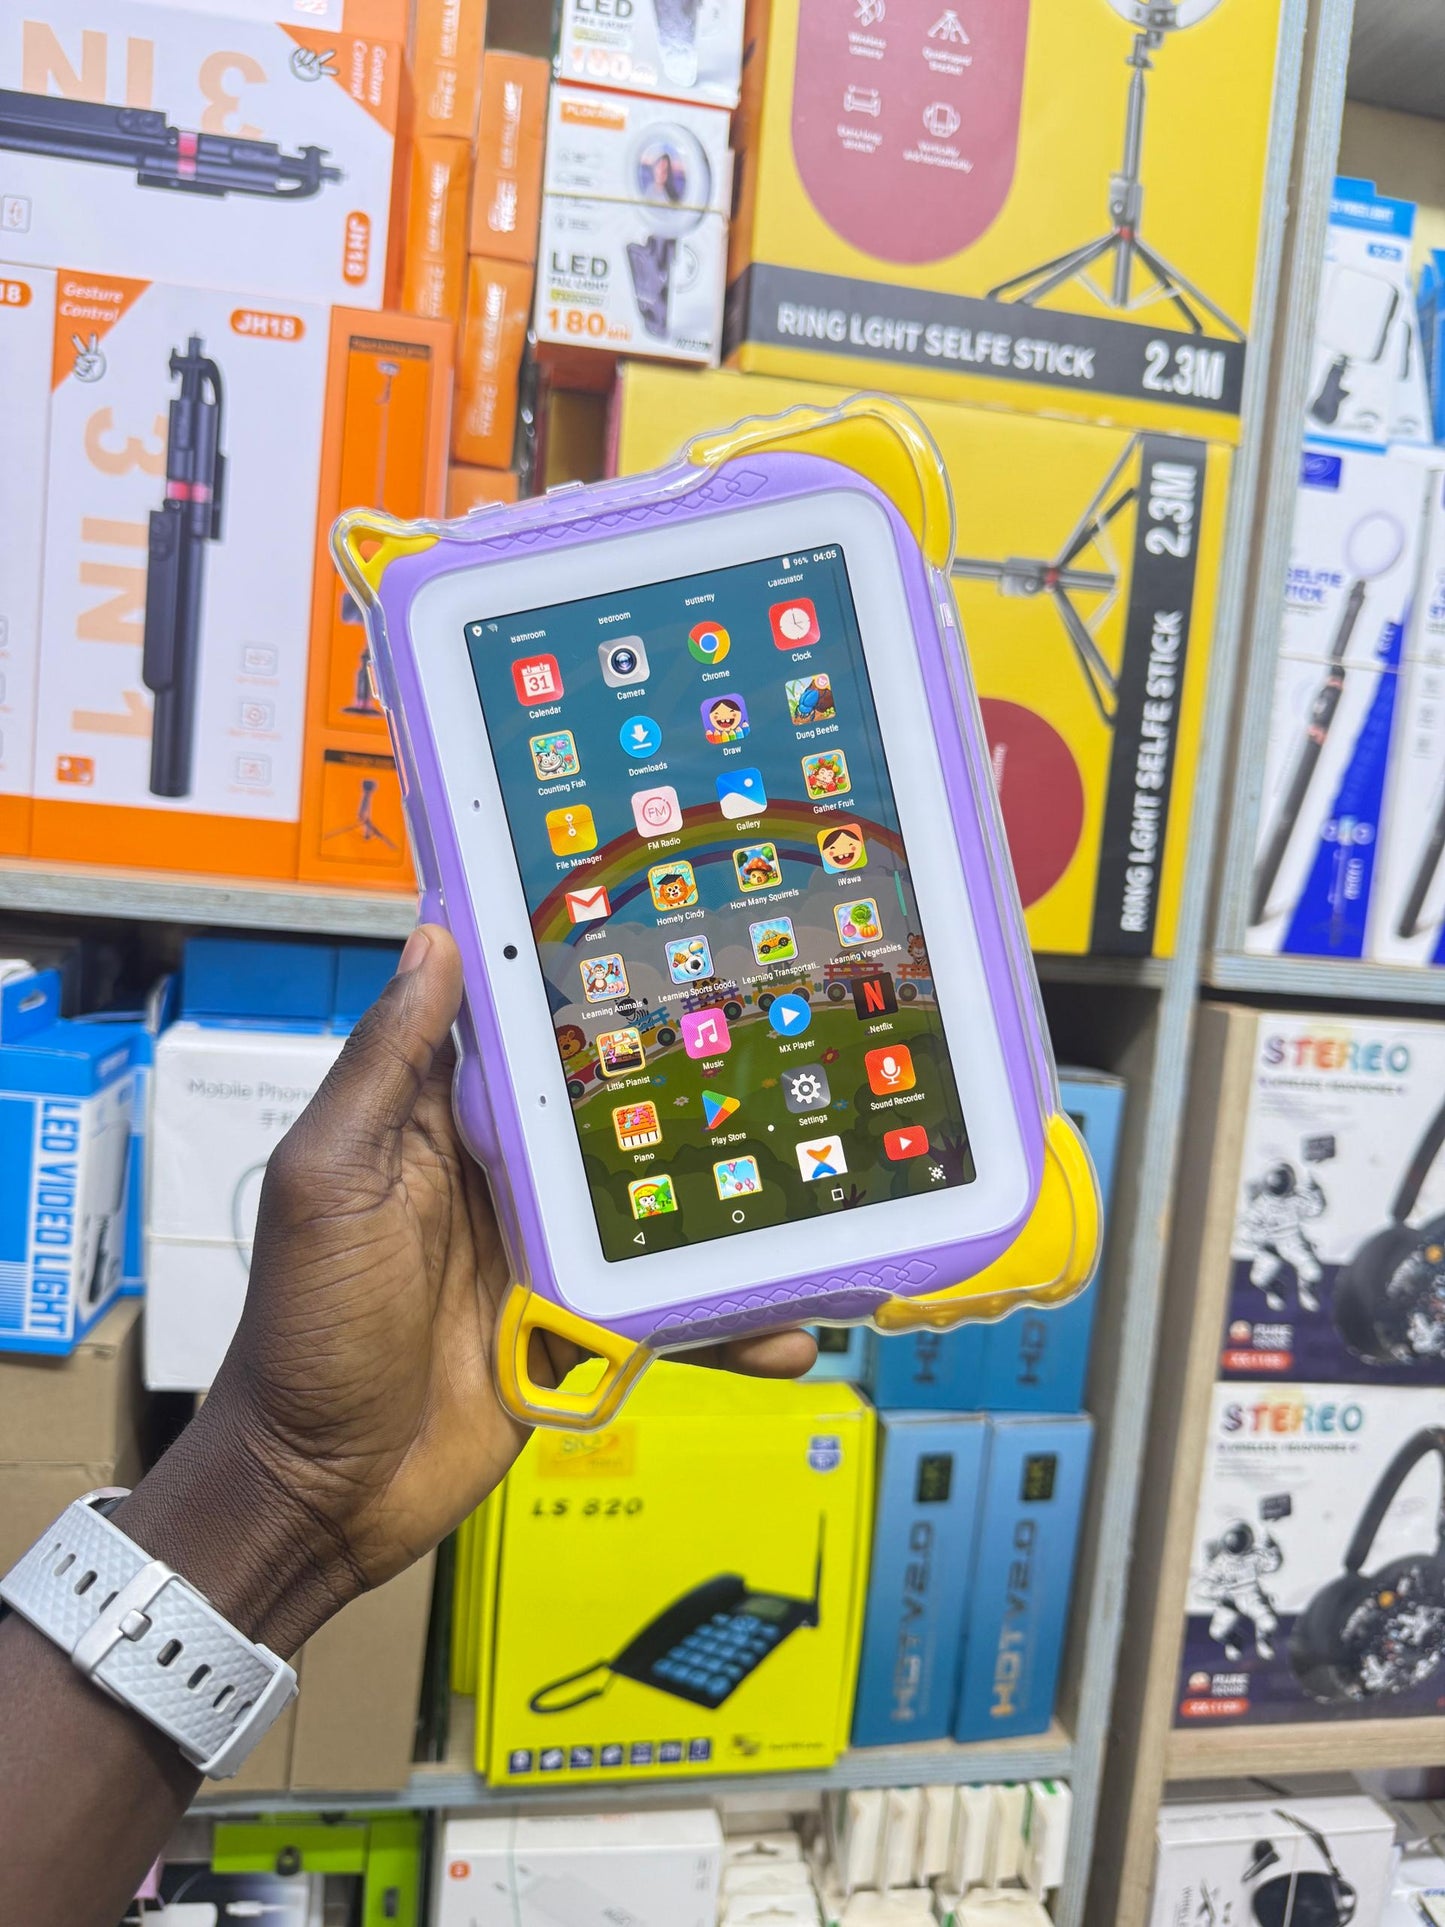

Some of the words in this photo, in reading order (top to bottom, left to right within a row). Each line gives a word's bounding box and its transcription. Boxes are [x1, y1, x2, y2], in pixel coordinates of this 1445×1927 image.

[351, 40, 368, 102] Control
[368, 45, 388, 106] Gesture
[550, 251, 610, 278] LED
[63, 281, 125, 304] Gesture
[59, 301, 120, 322] Control
[236, 313, 298, 339] JH18
[547, 309, 606, 339] 180
[776, 302, 847, 340] RING
[850, 312, 924, 350] LGHT
[925, 322, 1012, 366] SELFE
[1013, 336, 1097, 379] STICK
[1142, 340, 1226, 399] 2.3M
[1144, 461, 1199, 559] 2.3M
[793, 556, 809, 566] 96%
[813, 549, 837, 563] 04:05
[791, 651, 812, 662] Clock
[1145, 610, 1183, 699] STICK
[528, 676, 551, 692] 31
[701, 669, 731, 682] Chrome
[616, 688, 646, 700] Camera
[529, 705, 562, 719] Calendar
[796, 729, 815, 740] Dung
[816, 723, 839, 736] Beetle
[723, 746, 742, 756] Draw
[1134, 701, 1172, 791] SELFE
[628, 761, 668, 777] Downloads
[538, 782, 571, 796] Counting
[571, 779, 586, 790] Fish
[647, 805, 667, 819] FM
[813, 802, 837, 814] Gather
[838, 798, 855, 809] Fruit
[736, 819, 761, 831] Gallery
[1128, 795, 1161, 864] LGHT
[647, 840, 659, 850] FM
[660, 836, 681, 848] Radio
[556, 859, 570, 870] File
[570, 853, 603, 867] Manager
[837, 874, 862, 887] iWawa
[730, 899, 747, 910] How
[747, 894, 767, 906] Many
[768, 888, 800, 903] Squirrels
[1120, 866, 1155, 933] RING
[656, 913, 684, 926] Homely
[685, 909, 705, 921] Cindy
[584, 930, 607, 942] Gmail
[829, 951, 861, 965] Learning
[861, 942, 902, 959] Vegetables
[742, 971, 773, 985] Learning
[658, 989, 690, 1003] Learning
[690, 984, 713, 998] Sports
[713, 979, 737, 992] Goods
[581, 1005, 613, 1020] Learning
[614, 1000, 644, 1014] Animals
[869, 1022, 893, 1034] Netflix
[779, 1044, 792, 1054] MX
[792, 1039, 815, 1051] Player
[1263, 1034, 1411, 1075] STEREO
[702, 1059, 725, 1070] Music
[188, 1079, 253, 1100] Mobile
[606, 1080, 625, 1092] Little
[626, 1075, 651, 1088] Pianist
[870, 1099, 893, 1111] Sound
[894, 1092, 926, 1105] Recorder
[42, 1101, 81, 1154] LED
[798, 1114, 828, 1127] Settings
[711, 1136, 727, 1147] Play
[728, 1131, 747, 1142] Store
[633, 1152, 655, 1163] Piano
[35, 1160, 78, 1246] VIDEO
[29, 1250, 72, 1337] LIGHT
[1223, 1402, 1363, 1433] STEREO
[531, 1497, 571, 1517] LS
